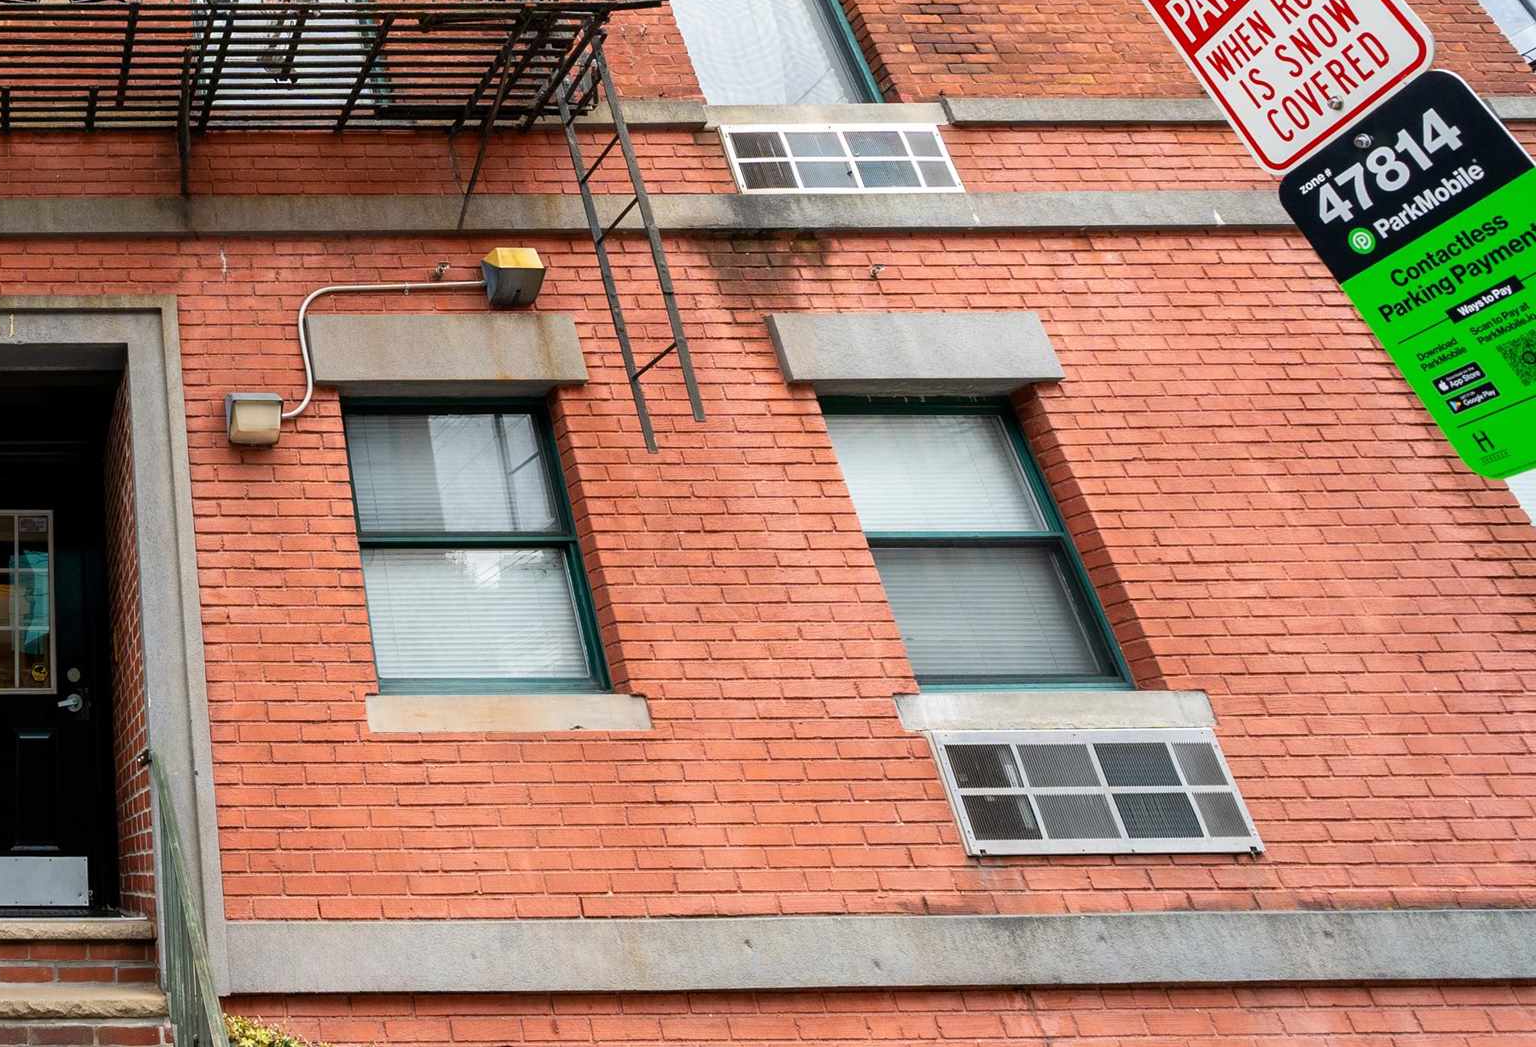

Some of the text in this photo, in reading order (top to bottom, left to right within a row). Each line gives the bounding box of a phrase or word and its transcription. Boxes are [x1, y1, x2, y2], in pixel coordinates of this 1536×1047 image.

[1206, 9, 1276, 81] WHEN
[1239, 68, 1275, 109] IS
[1266, 32, 1390, 142] COVERED
[1299, 173, 1326, 195] zone
[1318, 107, 1463, 225] 47814
[1373, 163, 1485, 239] ParkMobile
[1390, 215, 1509, 287] Contactless
[1378, 276, 1456, 323] Parking
[1457, 284, 1512, 316] Ways to Pay
